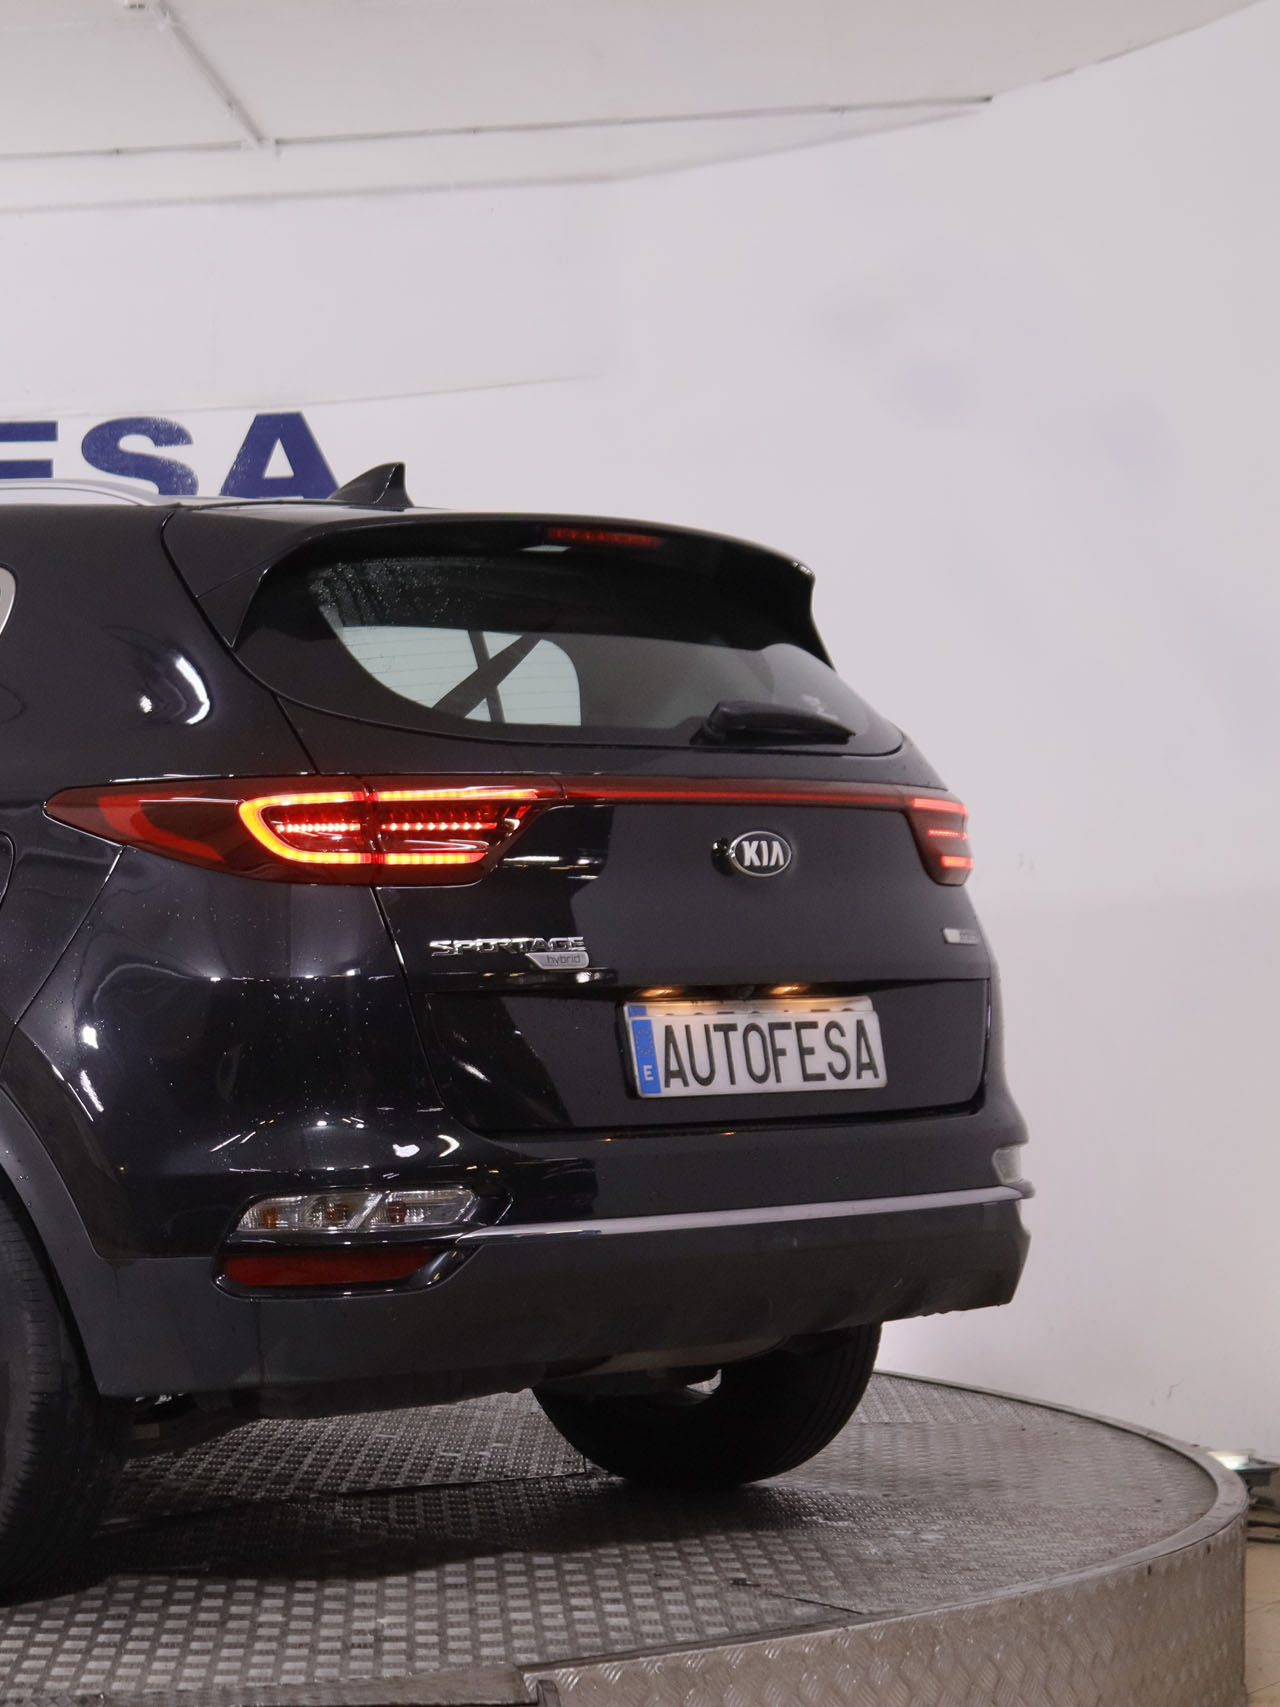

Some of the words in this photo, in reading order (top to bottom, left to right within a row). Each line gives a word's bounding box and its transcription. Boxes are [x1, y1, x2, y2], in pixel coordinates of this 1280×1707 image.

[742, 840, 785, 867] KIA
[429, 936, 586, 957] SPORTAGE
[546, 953, 581, 966] hybrid
[664, 1018, 881, 1089] AUTOFESA
[642, 1065, 654, 1081] E
